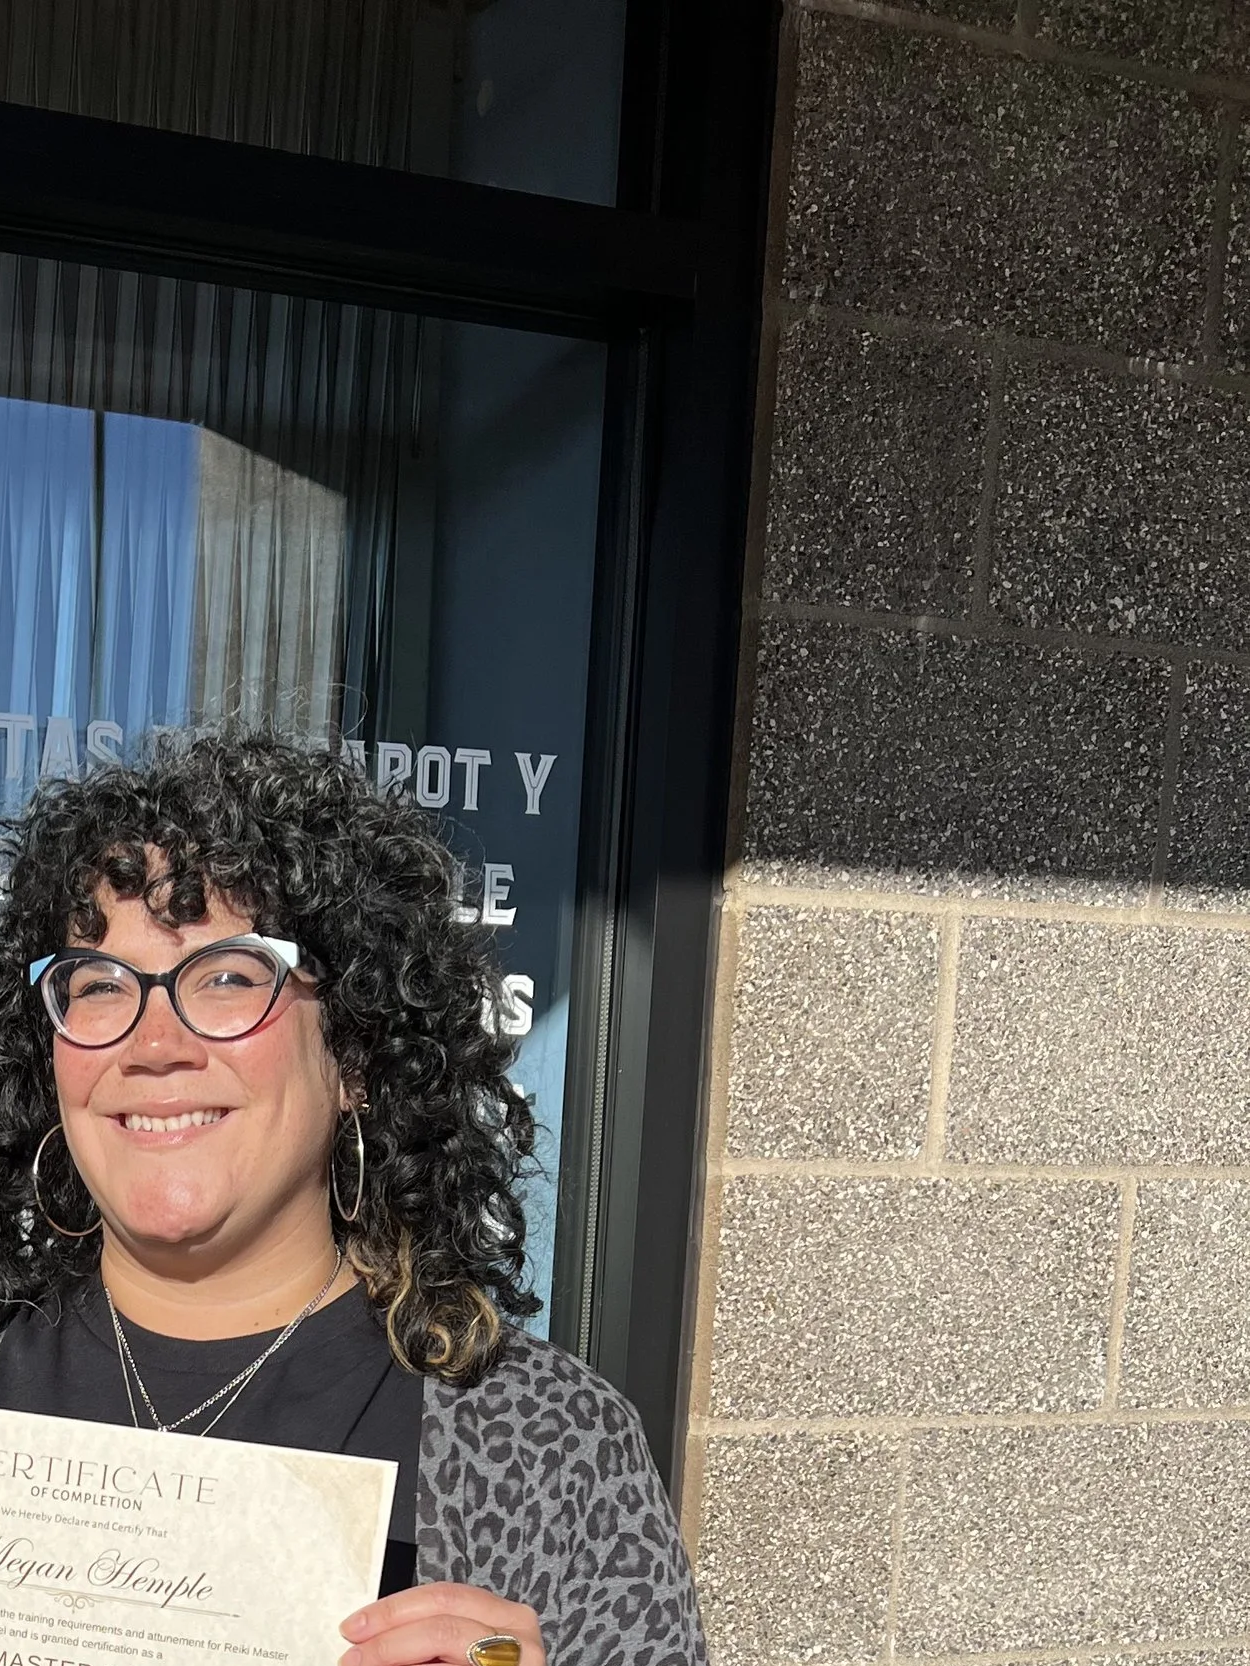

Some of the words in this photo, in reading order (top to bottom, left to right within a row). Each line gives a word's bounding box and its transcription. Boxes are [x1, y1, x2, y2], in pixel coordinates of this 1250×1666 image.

[514, 751, 558, 815] Y
[30, 1485, 49, 1500] OF
[51, 1488, 143, 1512] COMPLETION
[0, 1507, 17, 1518] We
[18, 1509, 53, 1524] Hereby
[54, 1513, 90, 1528] Declare
[91, 1519, 110, 1531] and
[111, 1521, 144, 1537] Certify
[145, 1526, 168, 1539] That
[86, 1548, 214, 1609] Hemple
[0, 1609, 16, 1621] the
[17, 1612, 55, 1628] training
[57, 1618, 123, 1637] requirements
[125, 1628, 145, 1640] and
[146, 1632, 205, 1649] attunement
[206, 1639, 222, 1651] for
[223, 1643, 251, 1656] Reiki
[252, 1647, 289, 1662] Master
[8, 1627, 28, 1639] and
[30, 1630, 39, 1641] is
[41, 1633, 80, 1648] granted
[81, 1639, 139, 1657] certification
[141, 1649, 154, 1659] as
[156, 1651, 164, 1660] a
